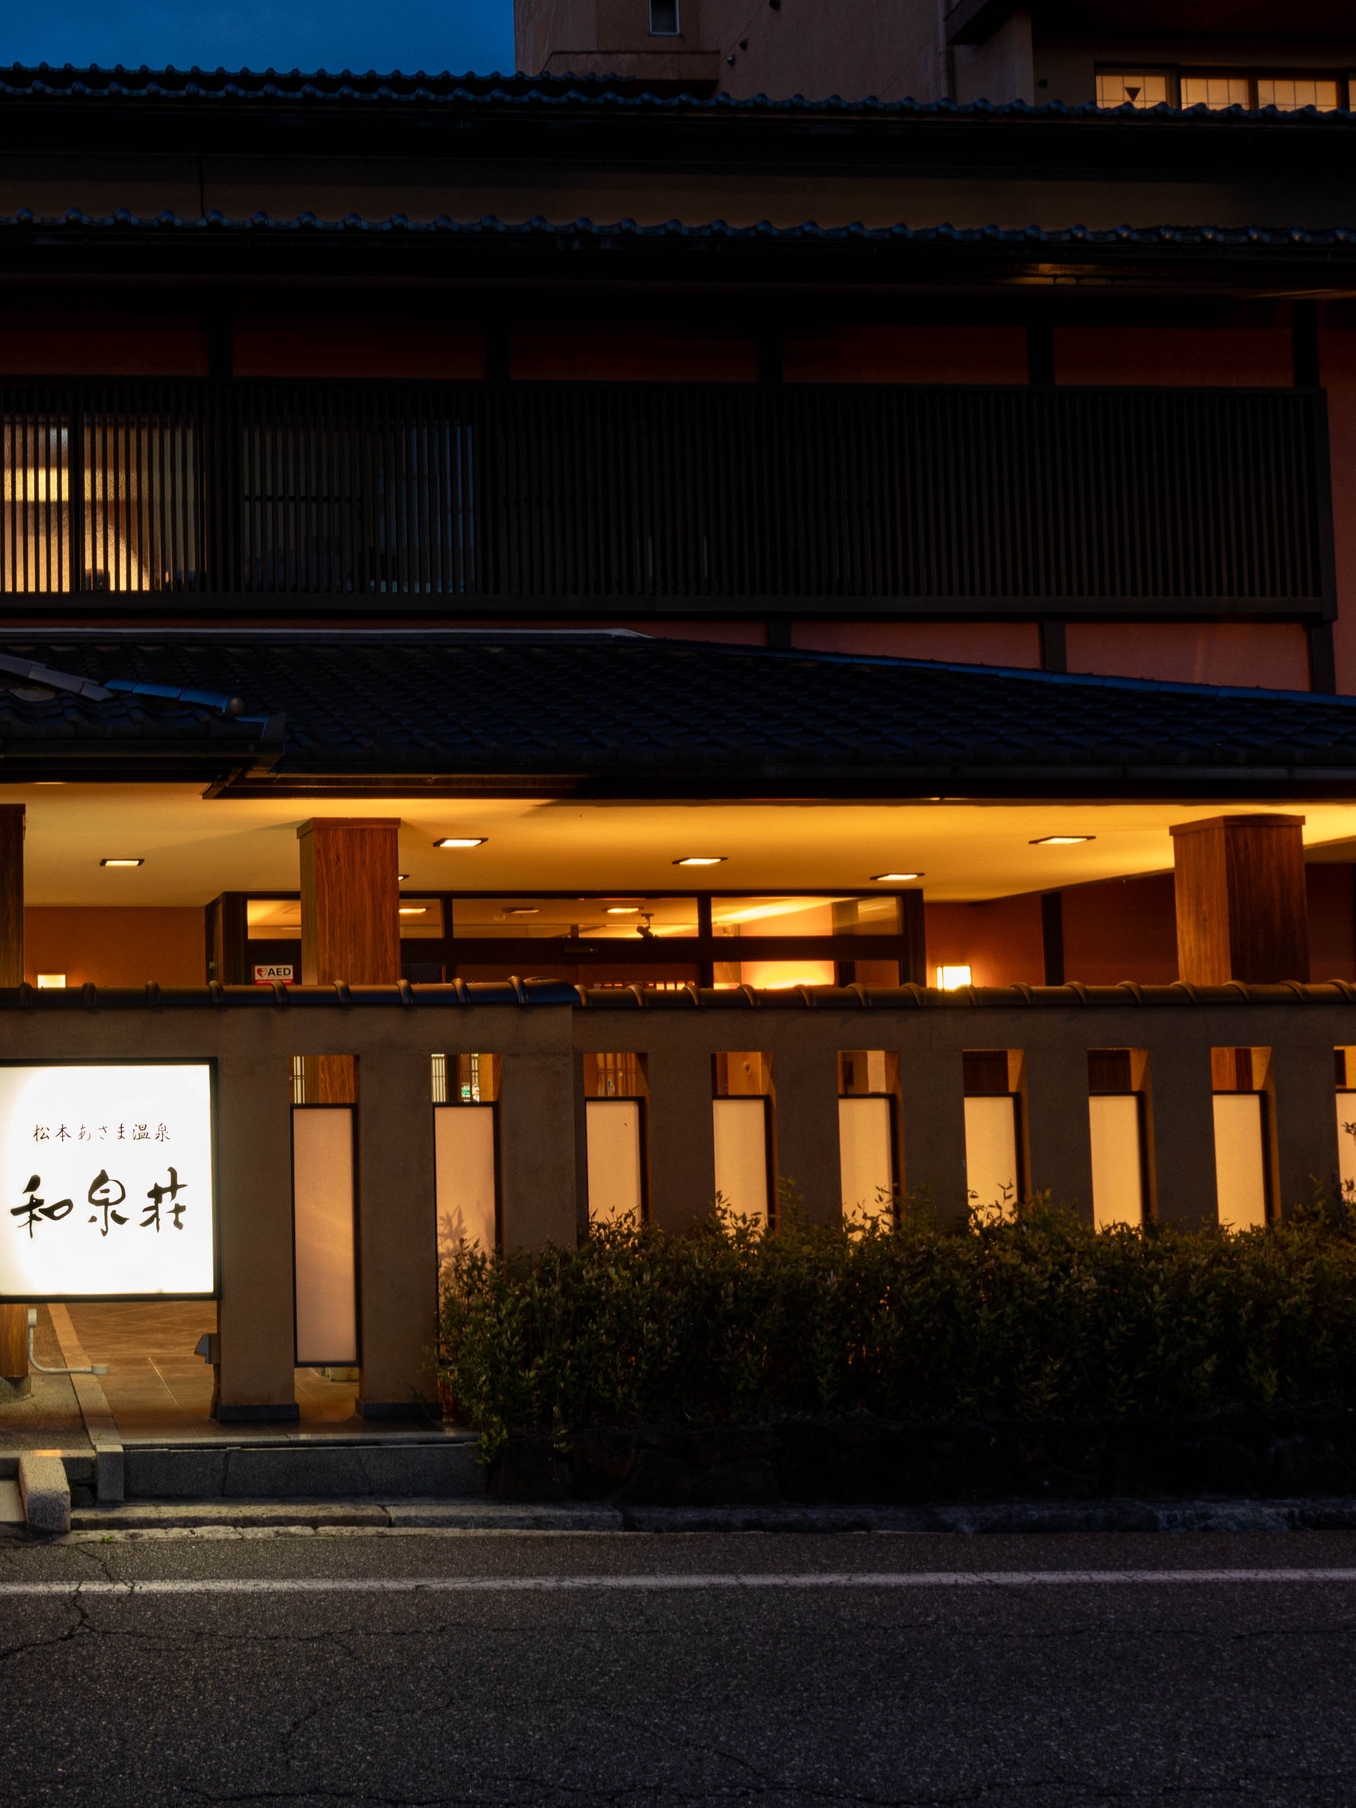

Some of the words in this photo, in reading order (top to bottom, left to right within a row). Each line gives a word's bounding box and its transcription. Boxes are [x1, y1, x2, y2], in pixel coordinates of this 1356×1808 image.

[267, 967, 291, 976] AED
[32, 1122, 171, 1142] 松本あさま温泉
[10, 1166, 188, 1239] 和泉荘
